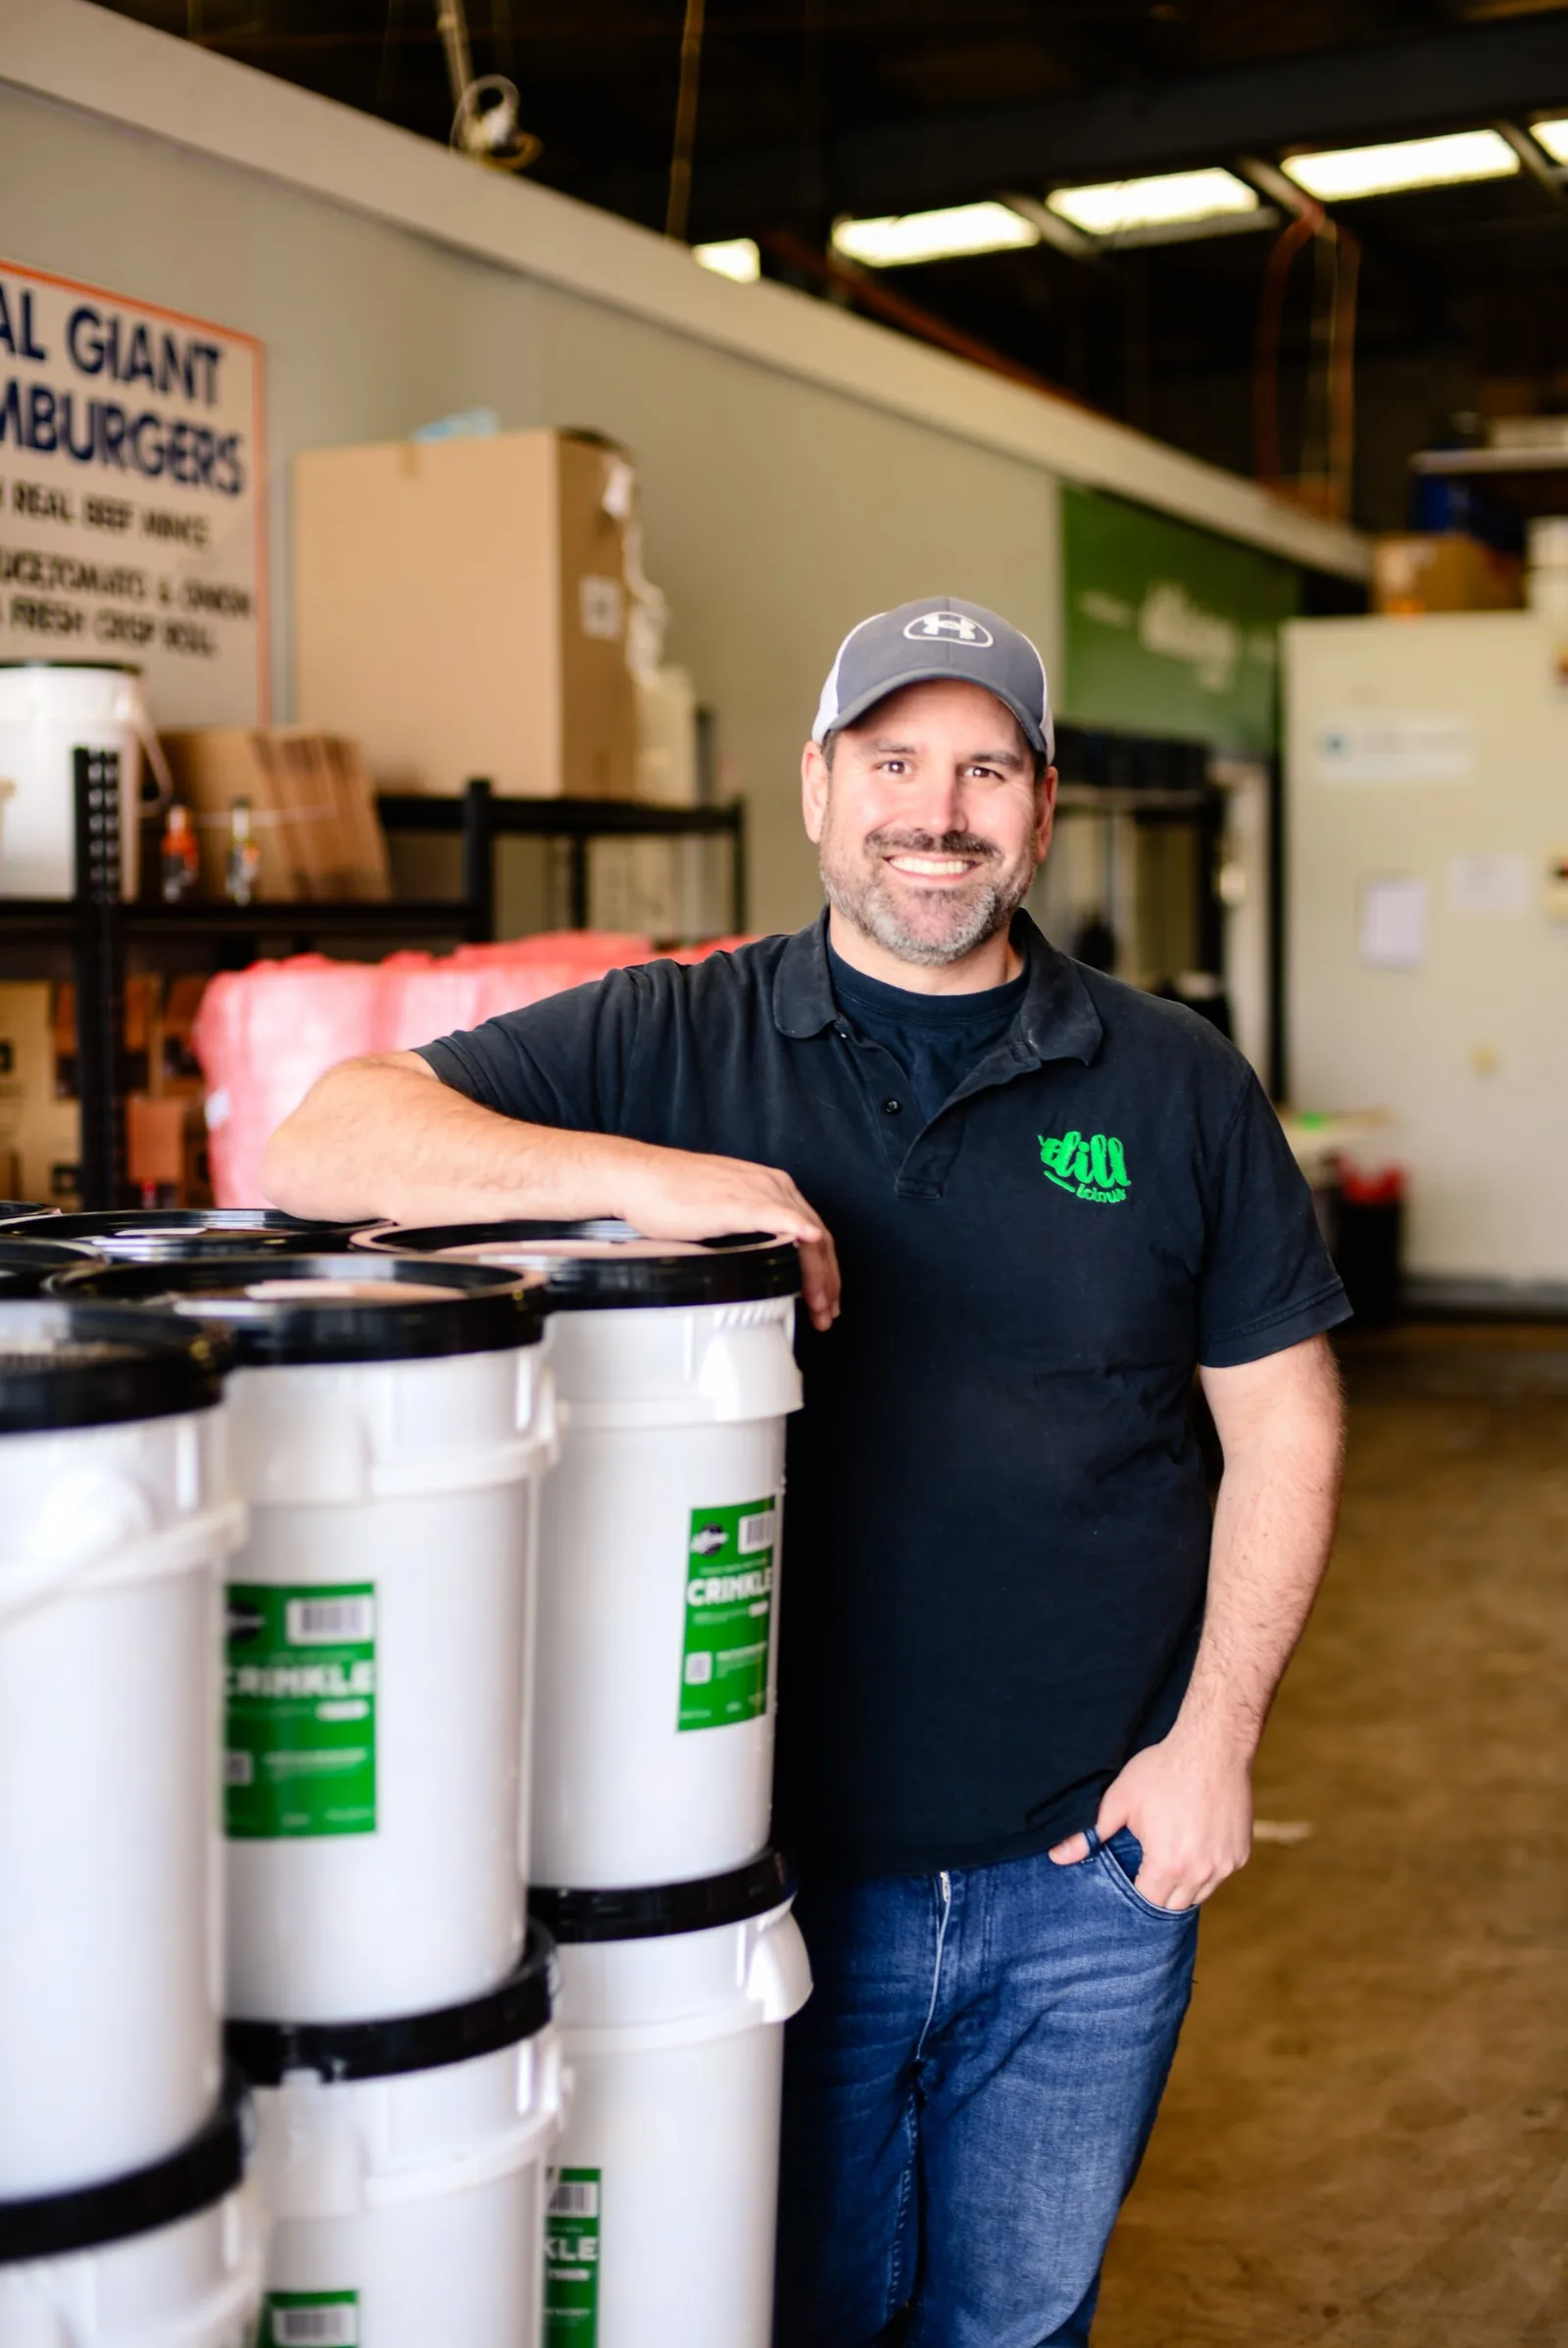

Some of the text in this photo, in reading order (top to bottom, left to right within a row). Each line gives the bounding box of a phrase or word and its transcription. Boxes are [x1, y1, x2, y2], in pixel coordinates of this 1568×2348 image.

[68, 307, 220, 408] GIANT
[13, 481, 74, 525] REAL
[687, 1567, 773, 1607] CRINKLE
